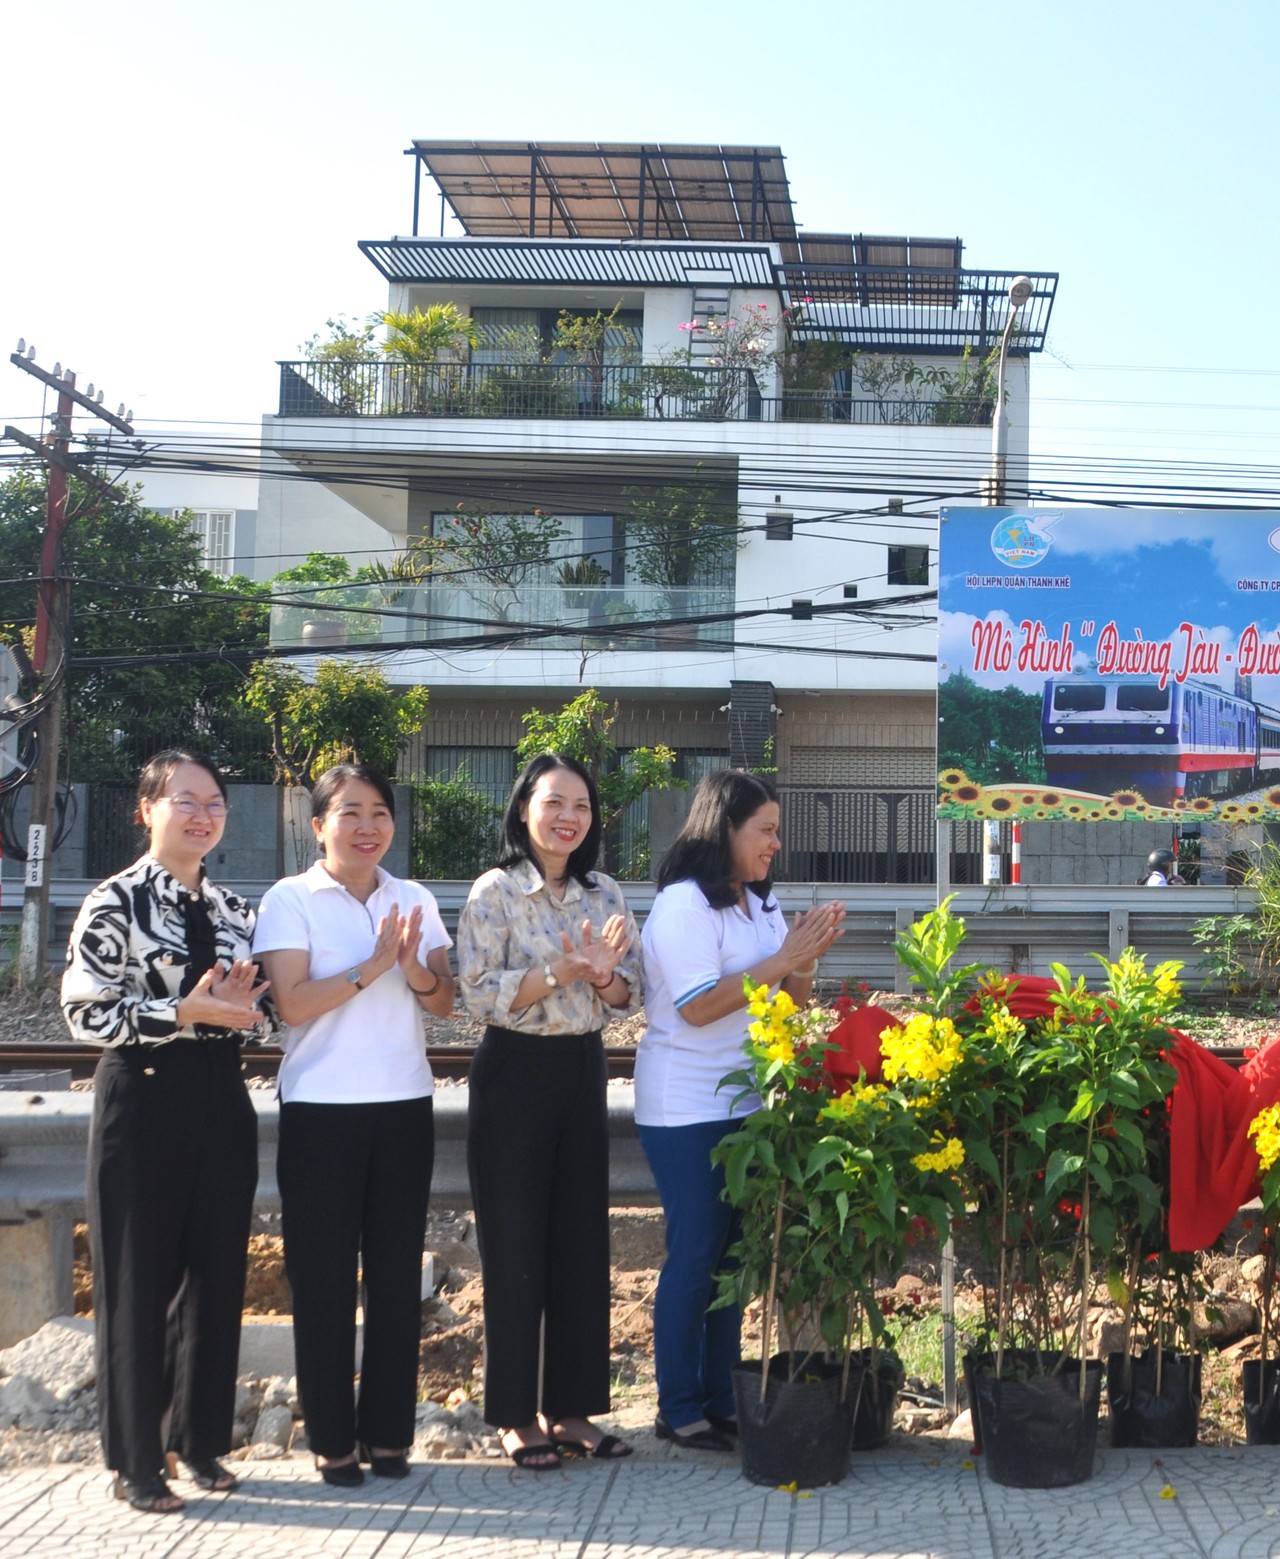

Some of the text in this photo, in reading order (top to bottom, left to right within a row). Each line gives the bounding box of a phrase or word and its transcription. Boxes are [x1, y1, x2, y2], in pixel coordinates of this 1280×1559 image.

[967, 574, 980, 589] HỘI
[982, 576, 1002, 587] LHPN
[1004, 574, 1025, 590] QUẬN
[1027, 576, 1053, 588] THANH
[1237, 578, 1258, 591] CÔNG
[1261, 580, 1269, 590] TY
[971, 620, 1013, 672] Mô
[1018, 620, 1072, 672] Hình
[1175, 622, 1220, 682] Tàu
